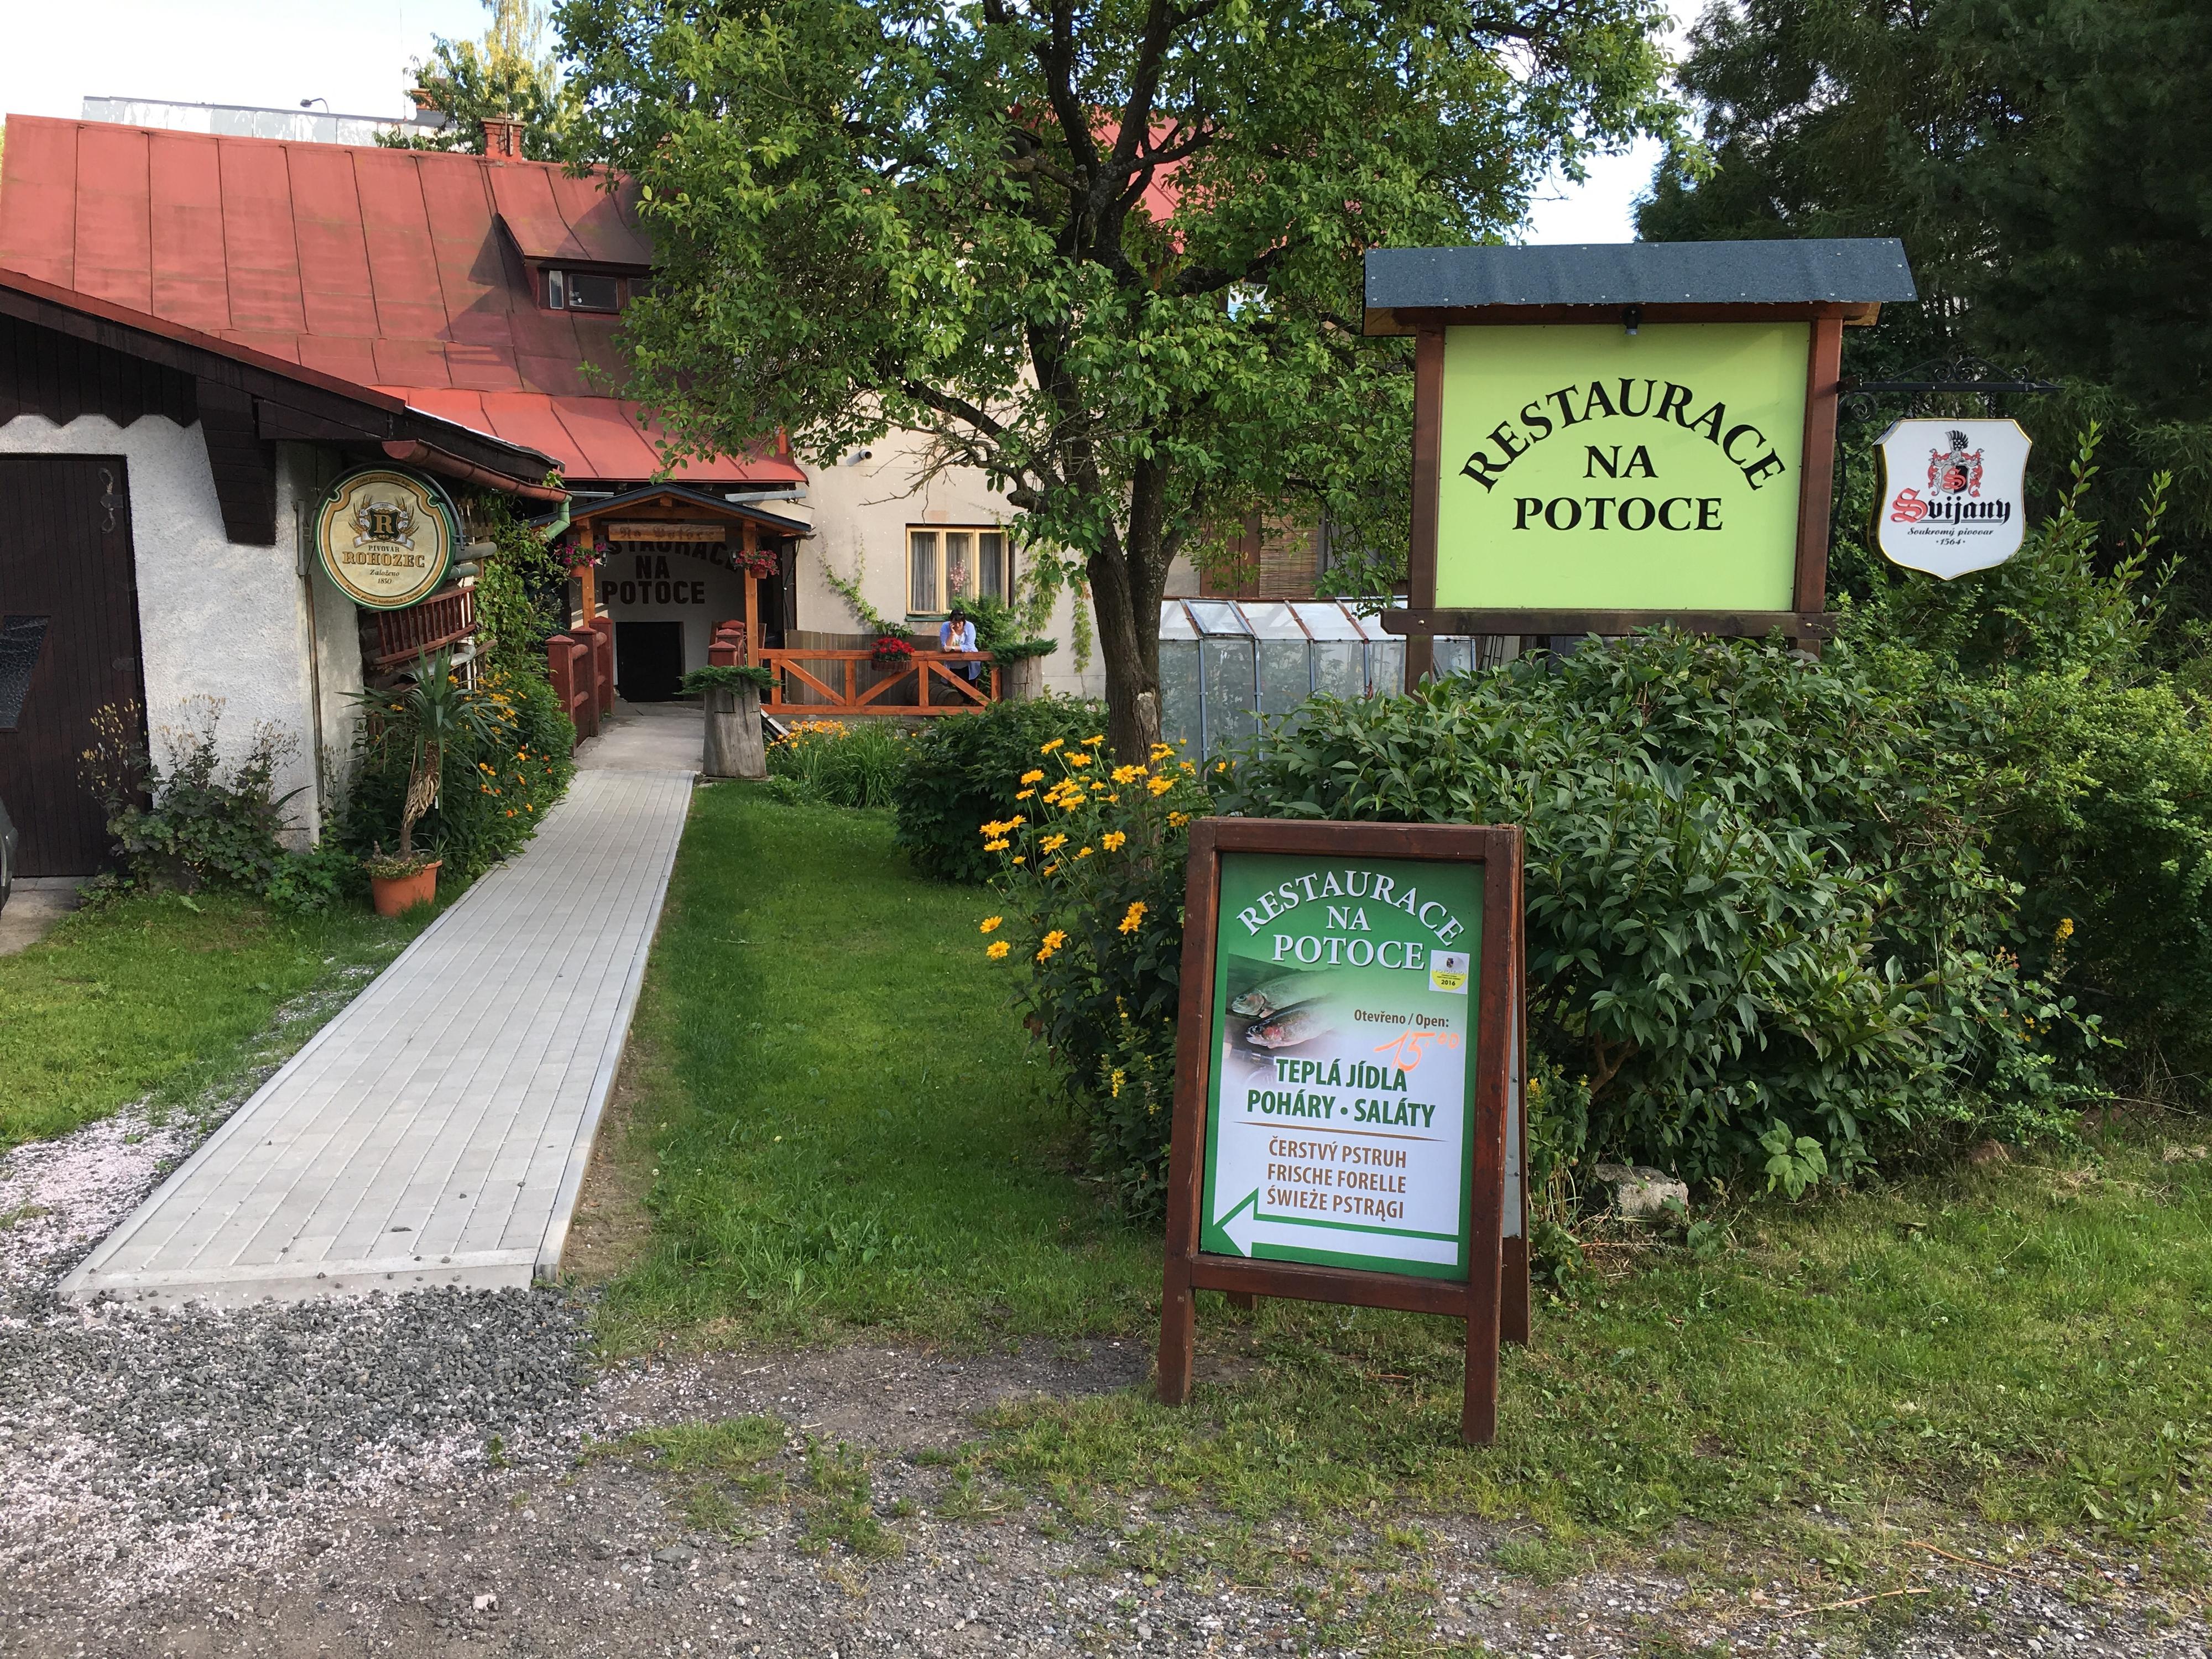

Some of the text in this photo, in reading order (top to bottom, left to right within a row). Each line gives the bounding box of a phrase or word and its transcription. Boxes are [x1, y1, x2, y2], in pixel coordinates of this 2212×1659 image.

[1458, 377, 1786, 494] RESTAURACE
[1583, 445, 1659, 479] NA
[1512, 497, 1724, 531] POTOCE
[1890, 488, 2011, 526] Svijany
[373, 514, 395, 534] R
[1907, 527, 1994, 538] Soukromý pivovar
[342, 551, 425, 568] ROHOZEC
[369, 568, 400, 577] Založeno
[635, 555, 670, 580] NA
[601, 581, 705, 605] POTOCE
[1237, 870, 1465, 947] RESTAURACE
[1326, 905, 1372, 931] NA
[1271, 933, 1426, 971] POTOCE
[1354, 1009, 1406, 1024] Otevřeno
[1416, 1014, 1449, 1029] Open:
[1276, 1058, 1407, 1092] TEPLÁ JÍDLA
[1247, 1088, 1436, 1128] POHÁRY SALÁTY
[1269, 1135, 1407, 1168] ČERSTVÝ PSTRUH
[1267, 1163, 1406, 1194] FRISCHE FORELLE
[1266, 1185, 1404, 1222] ŚWIEŻE PSTRĄGI
